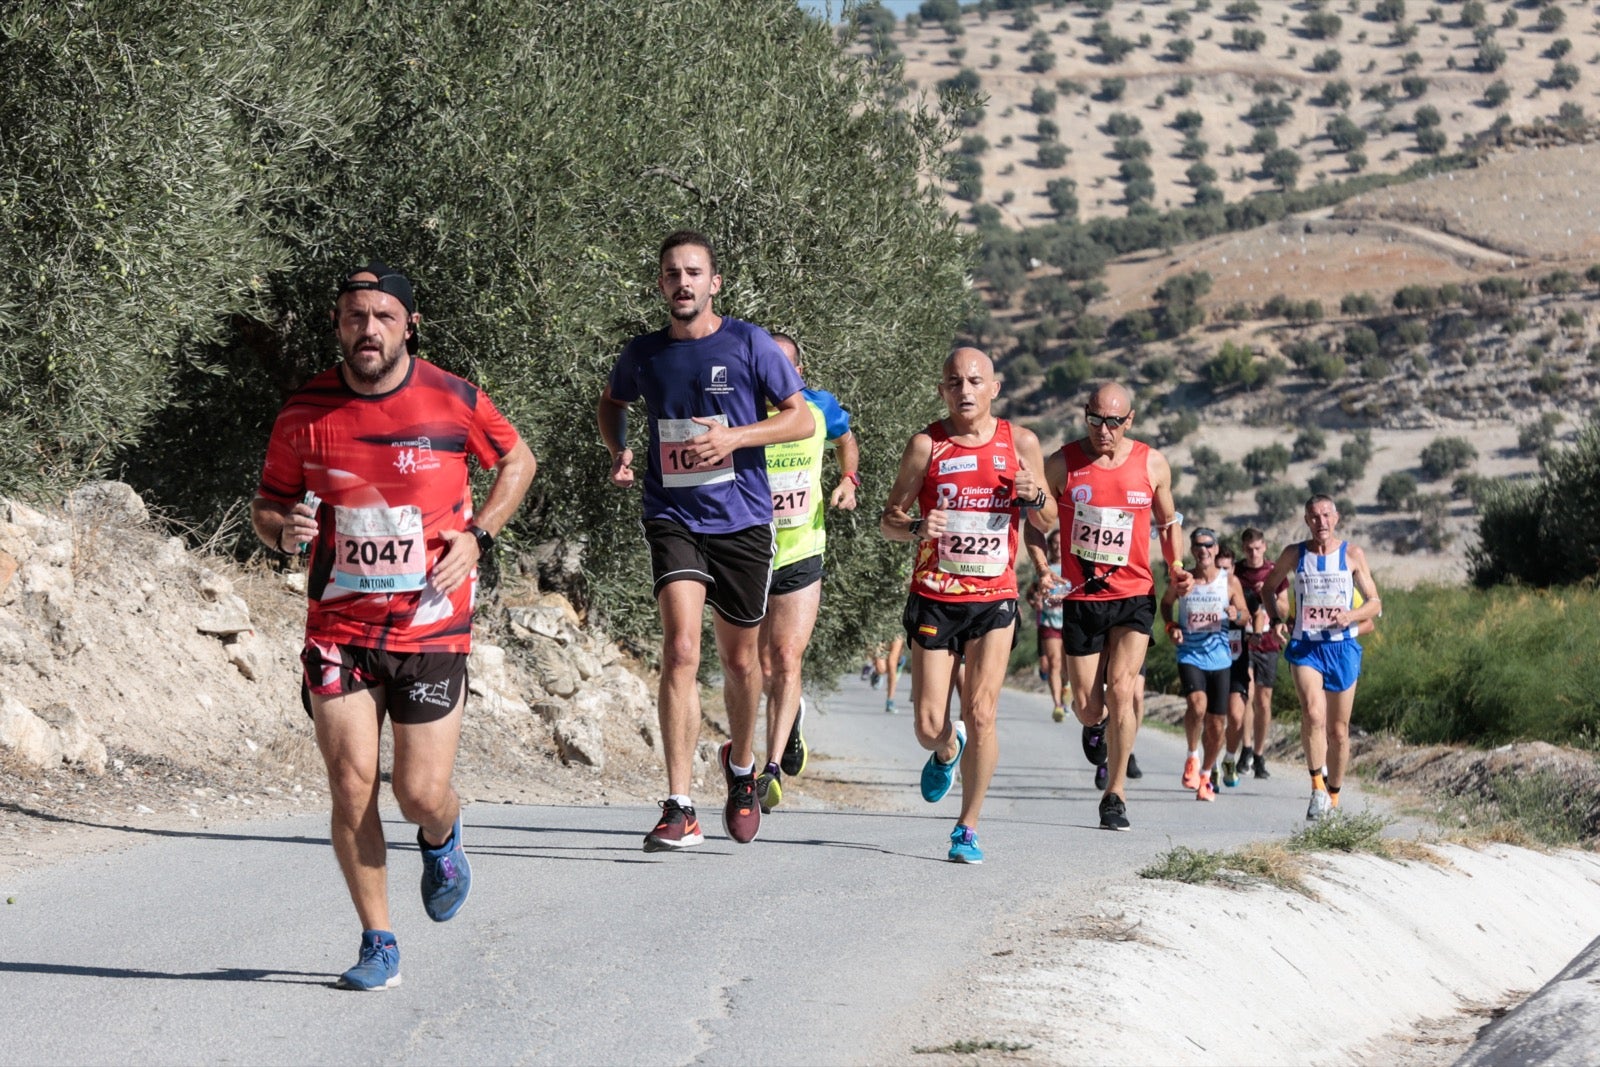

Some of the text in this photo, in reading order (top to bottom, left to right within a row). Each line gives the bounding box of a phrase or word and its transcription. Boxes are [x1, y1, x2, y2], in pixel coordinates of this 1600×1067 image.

[669, 449, 723, 470] 10
[766, 456, 812, 468] RACENA
[773, 491, 806, 511] 217
[1080, 525, 1124, 547] 2194
[345, 539, 414, 565] 2047
[950, 535, 1001, 555] 2222
[1083, 550, 1109, 561] FAUSTINO
[960, 564, 985, 573] MANUEL
[359, 578, 395, 589] ANTONIO
[1192, 613, 1218, 623] 2240
